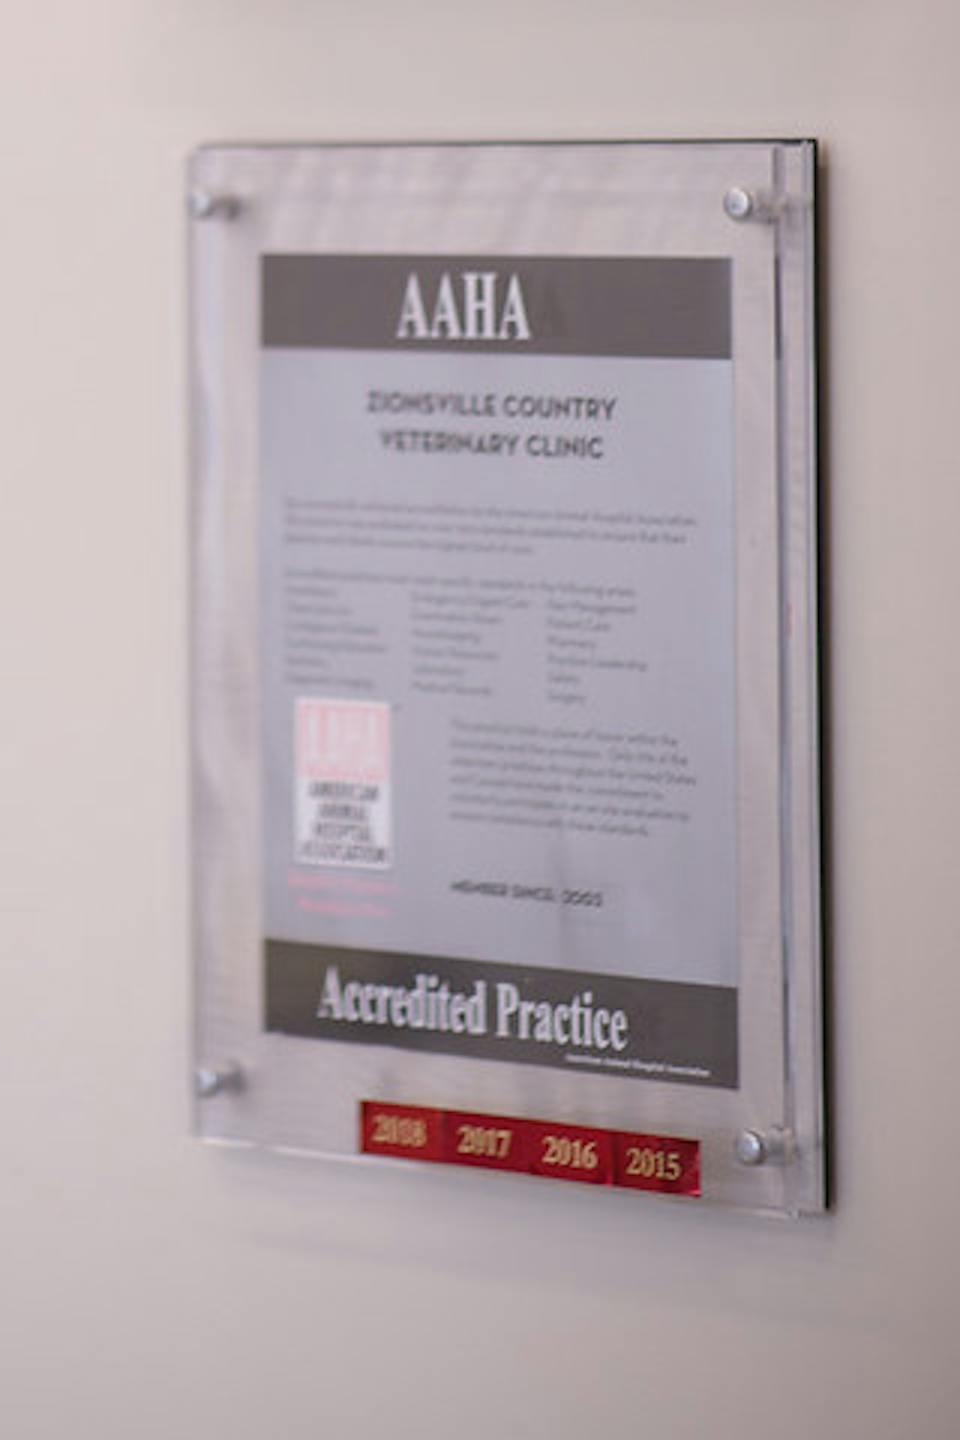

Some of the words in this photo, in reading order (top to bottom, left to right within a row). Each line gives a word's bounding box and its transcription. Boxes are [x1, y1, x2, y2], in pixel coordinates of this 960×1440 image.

[396, 271, 533, 341] AAHA
[366, 390, 497, 419] ZIONSVILLE
[503, 394, 619, 423] COUNTRY
[378, 429, 520, 457] VETERINARY
[525, 433, 604, 459] CLINIC
[317, 966, 488, 1035] Accredited
[495, 982, 629, 1051] Practice
[456, 1124, 513, 1160] 2017
[541, 1135, 599, 1170] 2016
[625, 1147, 683, 1181] 2015
